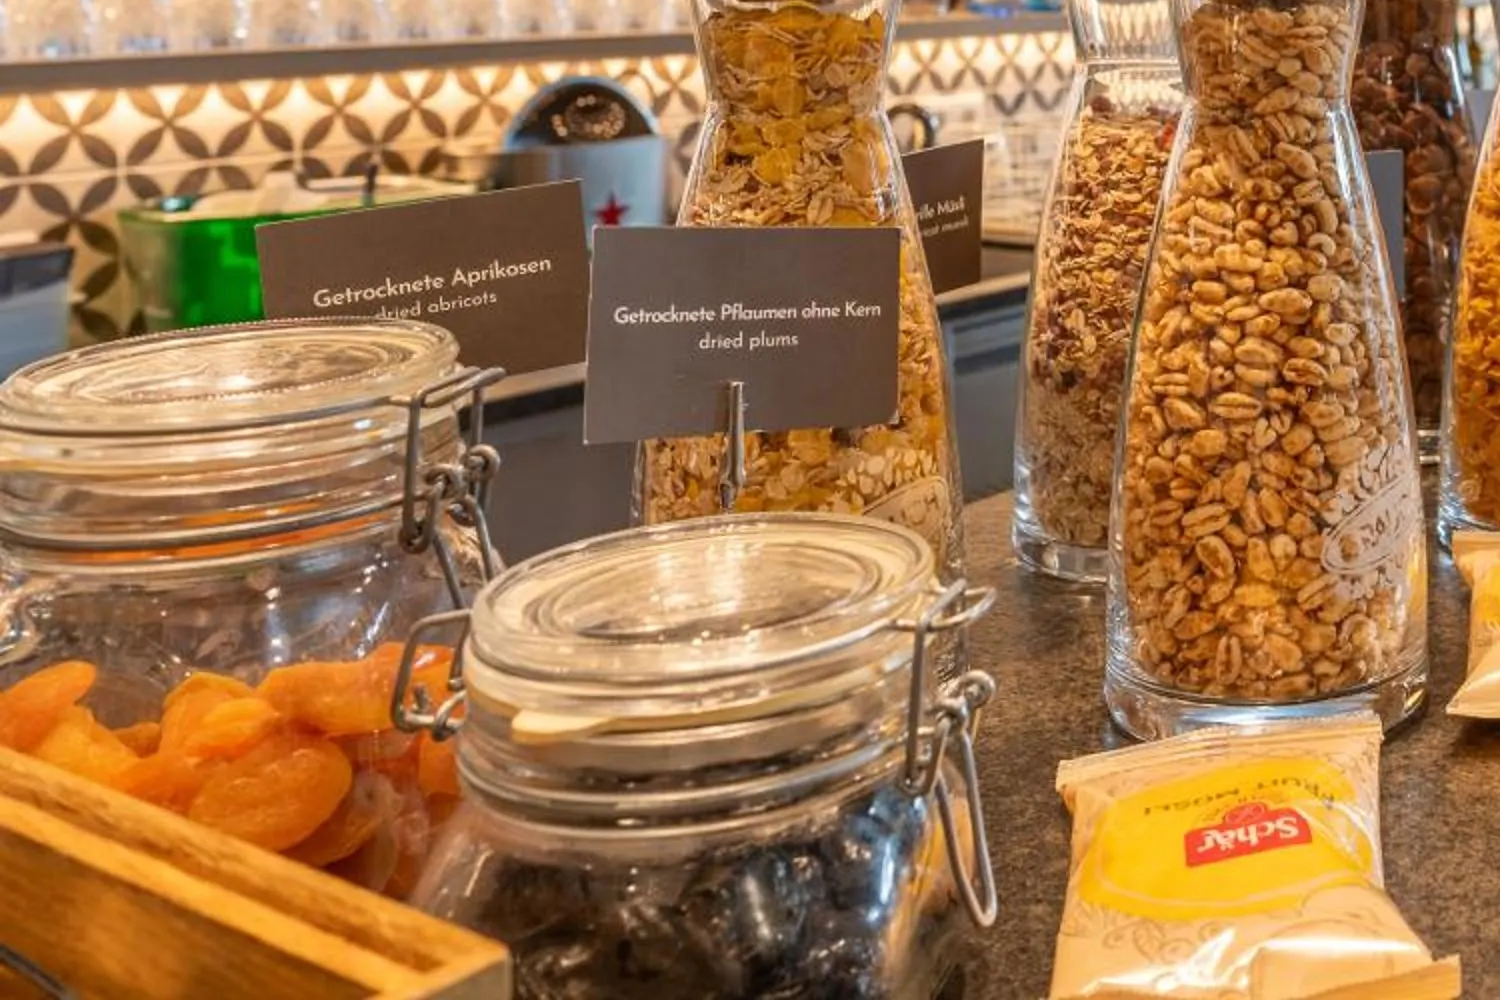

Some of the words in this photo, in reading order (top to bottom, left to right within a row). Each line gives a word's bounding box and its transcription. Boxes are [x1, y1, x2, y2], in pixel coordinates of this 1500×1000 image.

[313, 276, 445, 308] Getrocknete
[451, 258, 552, 287] Aprikosen
[374, 301, 421, 320] dried
[428, 291, 497, 313] abricots
[613, 304, 716, 324] Getrocknete
[720, 303, 797, 321] Pflaumen
[801, 301, 841, 319] ohne
[845, 300, 881, 317] Kern
[699, 331, 743, 350] dried
[749, 330, 799, 351] plums
[1196, 815, 1300, 854] Schär
